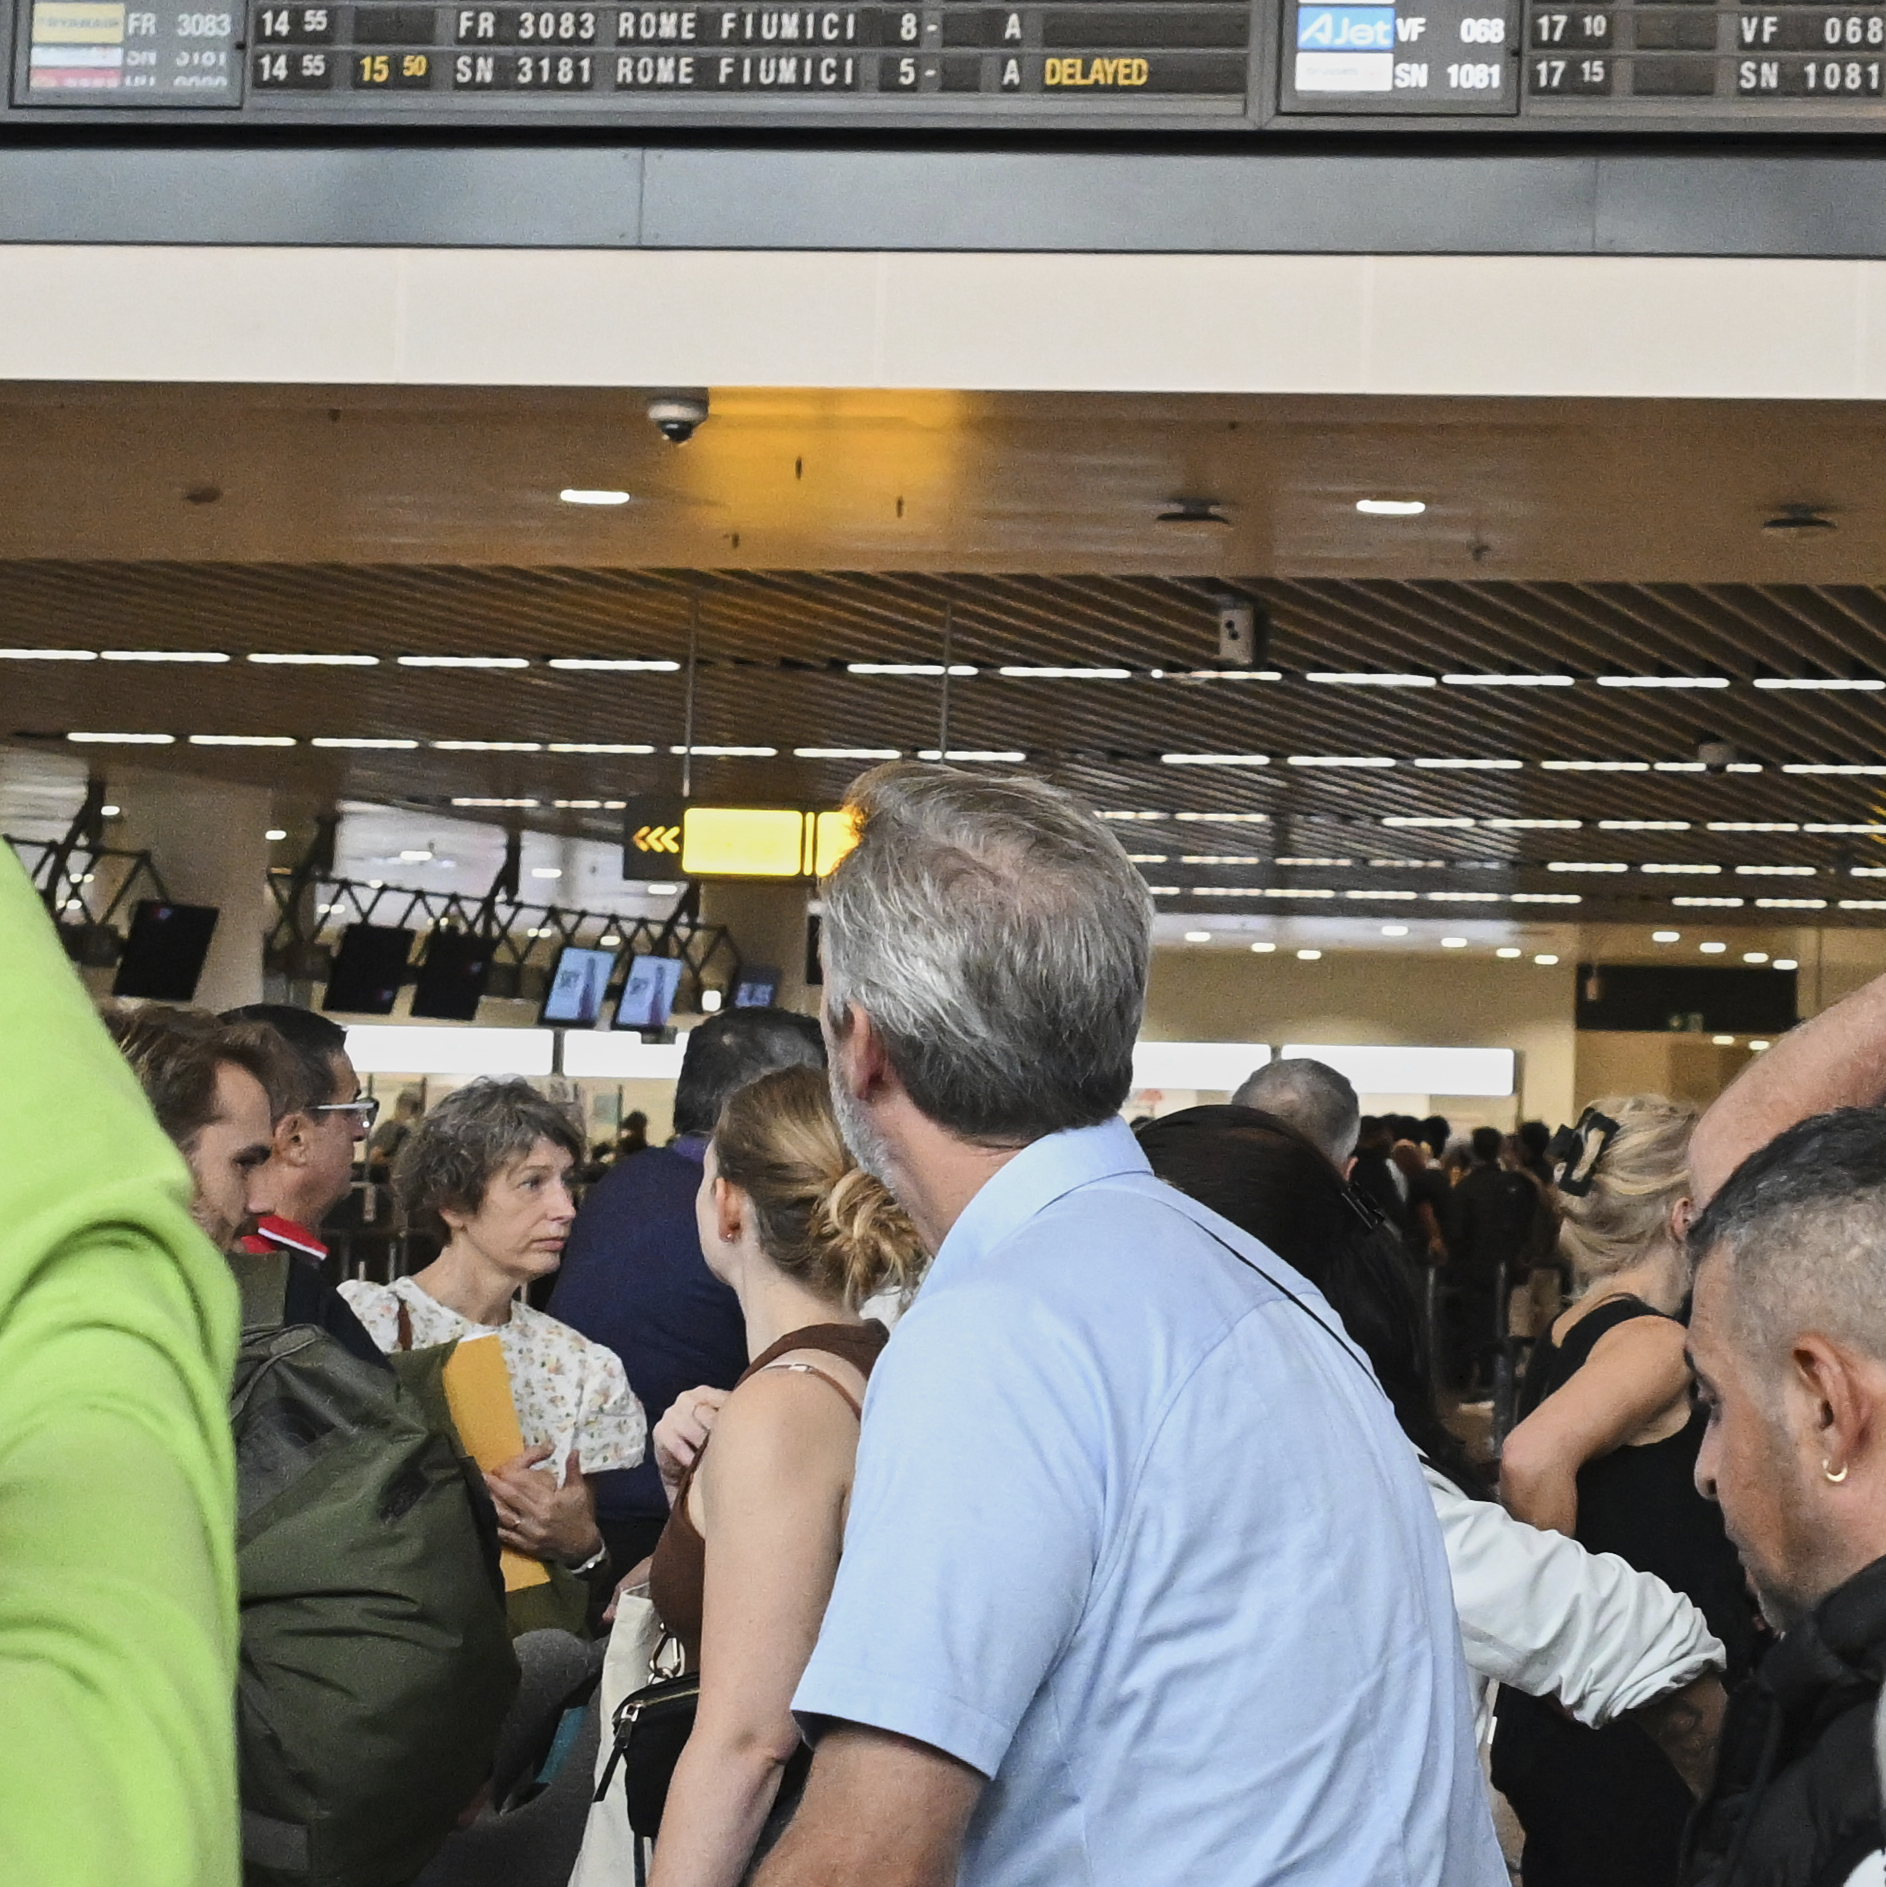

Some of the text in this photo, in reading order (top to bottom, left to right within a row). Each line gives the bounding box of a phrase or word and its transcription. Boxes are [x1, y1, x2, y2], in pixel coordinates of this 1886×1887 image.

[1299, 12, 1393, 46] AJet
[617, 56, 1148, 85] ROME FIUMICI DELAYED
